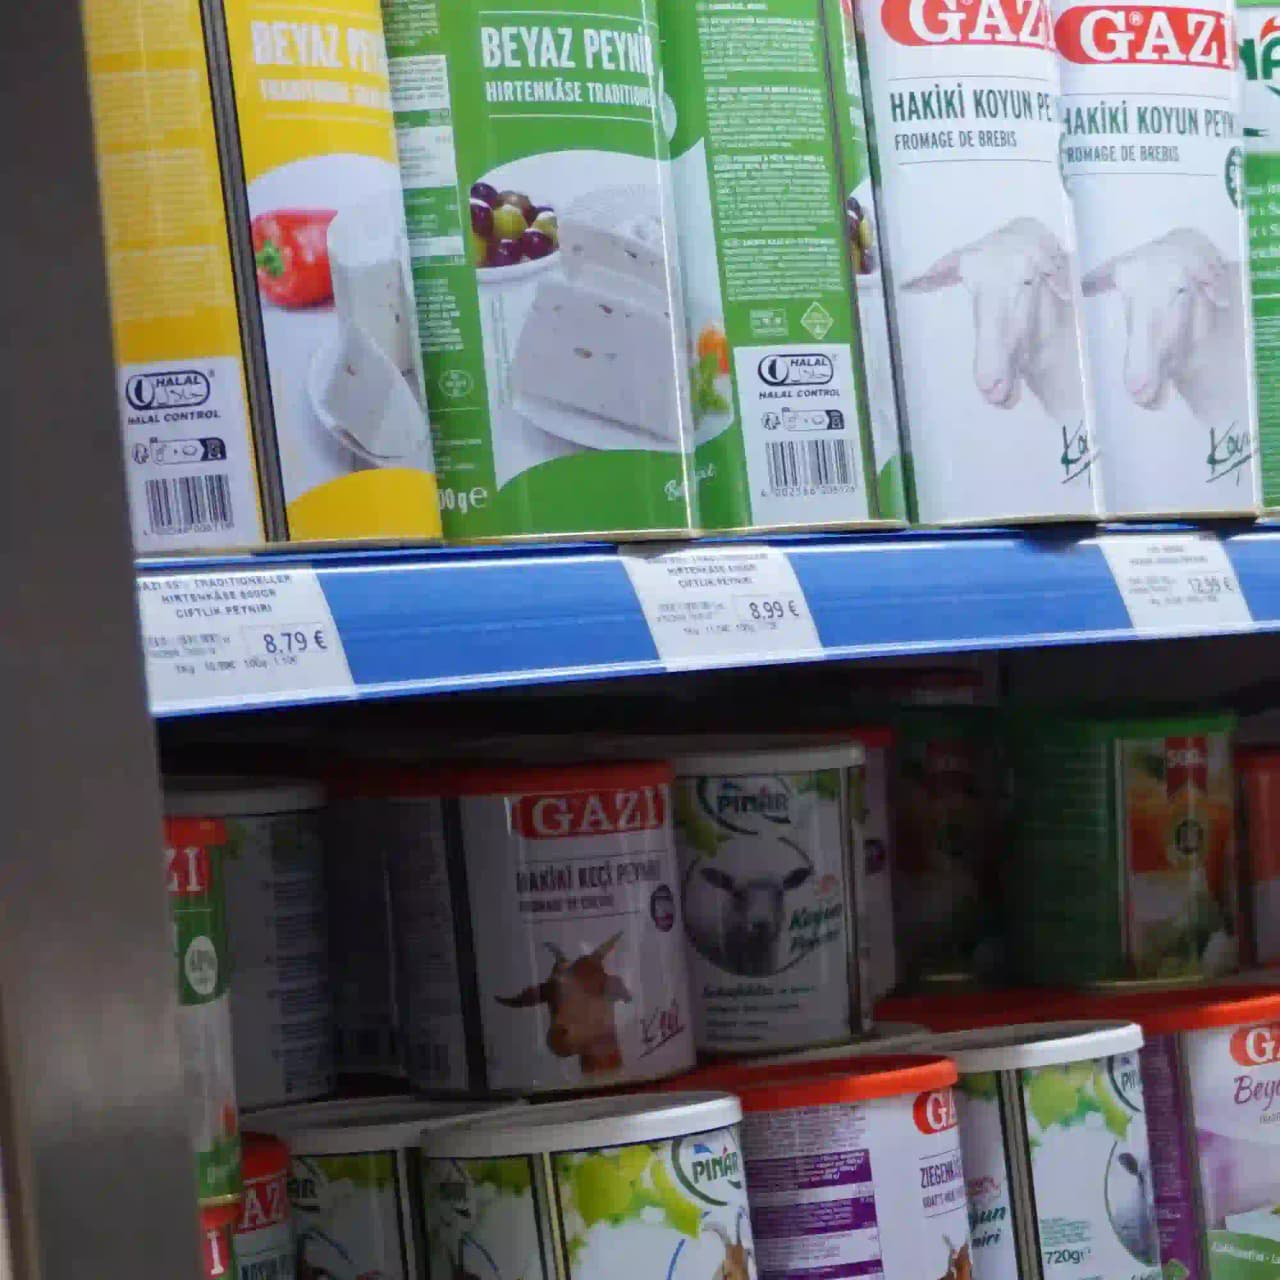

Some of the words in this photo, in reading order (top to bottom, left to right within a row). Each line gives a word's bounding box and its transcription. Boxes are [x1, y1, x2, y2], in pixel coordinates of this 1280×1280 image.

[251, 21, 343, 67] BEYAZ
[480, 27, 575, 69] BEYAZ
[486, 78, 583, 104] HIRTENKÄSE
[890, 83, 966, 123] HAKİKİ
[974, 84, 1033, 121] KOYUN
[1137, 105, 1199, 136] KOYUN
[895, 133, 954, 151] FROMAGE
[958, 131, 974, 148] DE
[978, 129, 1018, 148] BREBIS
[1121, 145, 1137, 161] DE
[1140, 144, 1180, 163] BREBIS
[790, 358, 828, 369] HALAL
[155, 374, 203, 388] HALAL
[759, 389, 793, 400] HALAL
[796, 387, 840, 399] CONTROL
[162, 410, 221, 423] CONTROL
[788, 599, 800, 618] €
[315, 629, 328, 651] €
[531, 786, 664, 836] GAZI
[1044, 1249, 1082, 1266] 720g
